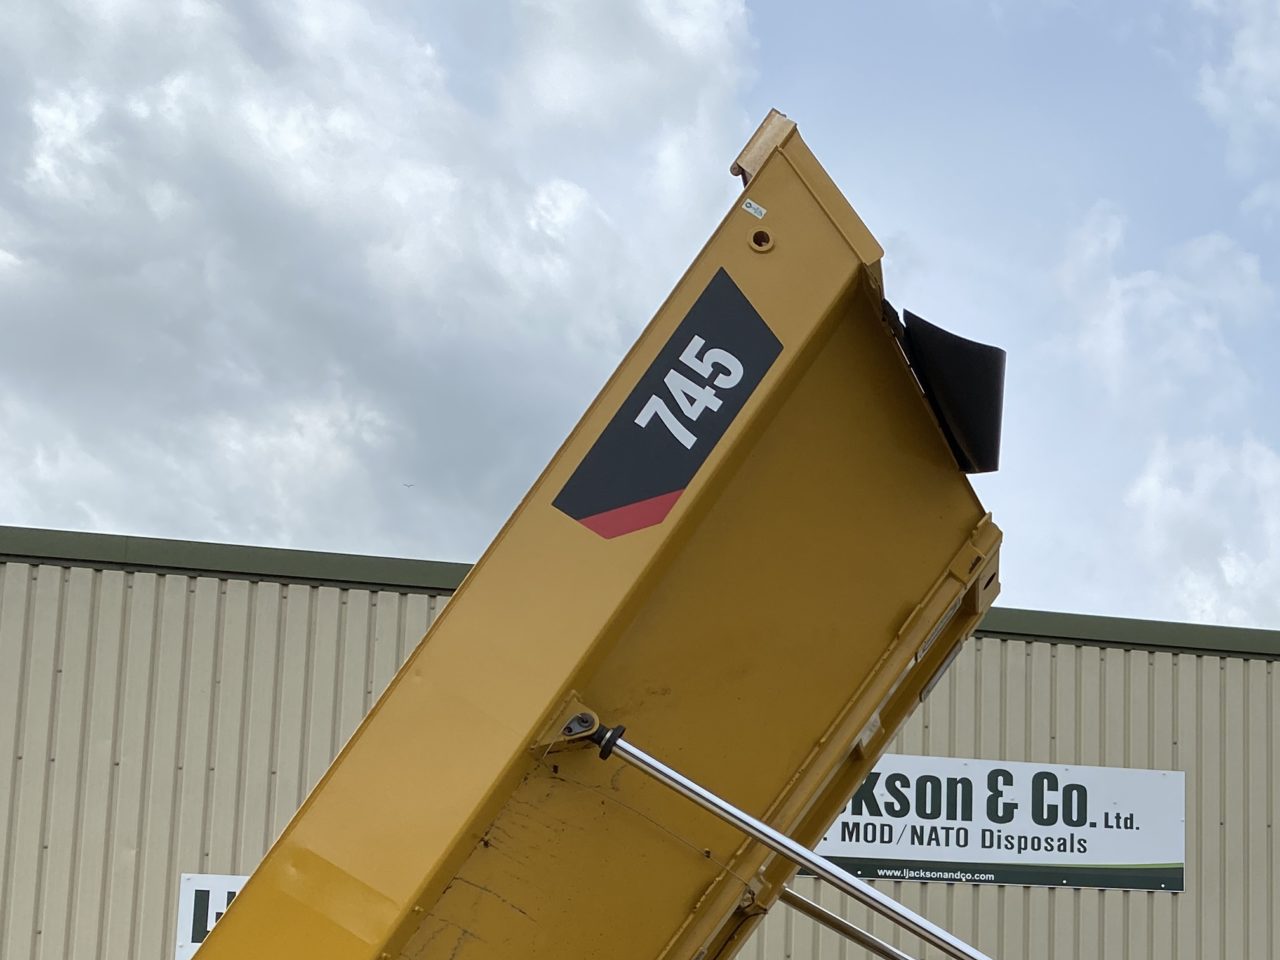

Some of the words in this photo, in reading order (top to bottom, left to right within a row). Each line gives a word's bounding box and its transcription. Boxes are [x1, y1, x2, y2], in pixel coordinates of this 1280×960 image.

[634, 334, 744, 450] 745
[840, 771, 974, 822] kson
[986, 769, 1019, 824] &
[1031, 771, 1097, 828] Co.
[1104, 812, 1140, 831] Ltd.
[981, 828, 1088, 855] Disposals
[877, 868, 995, 881] www.ljacksonandco.com
